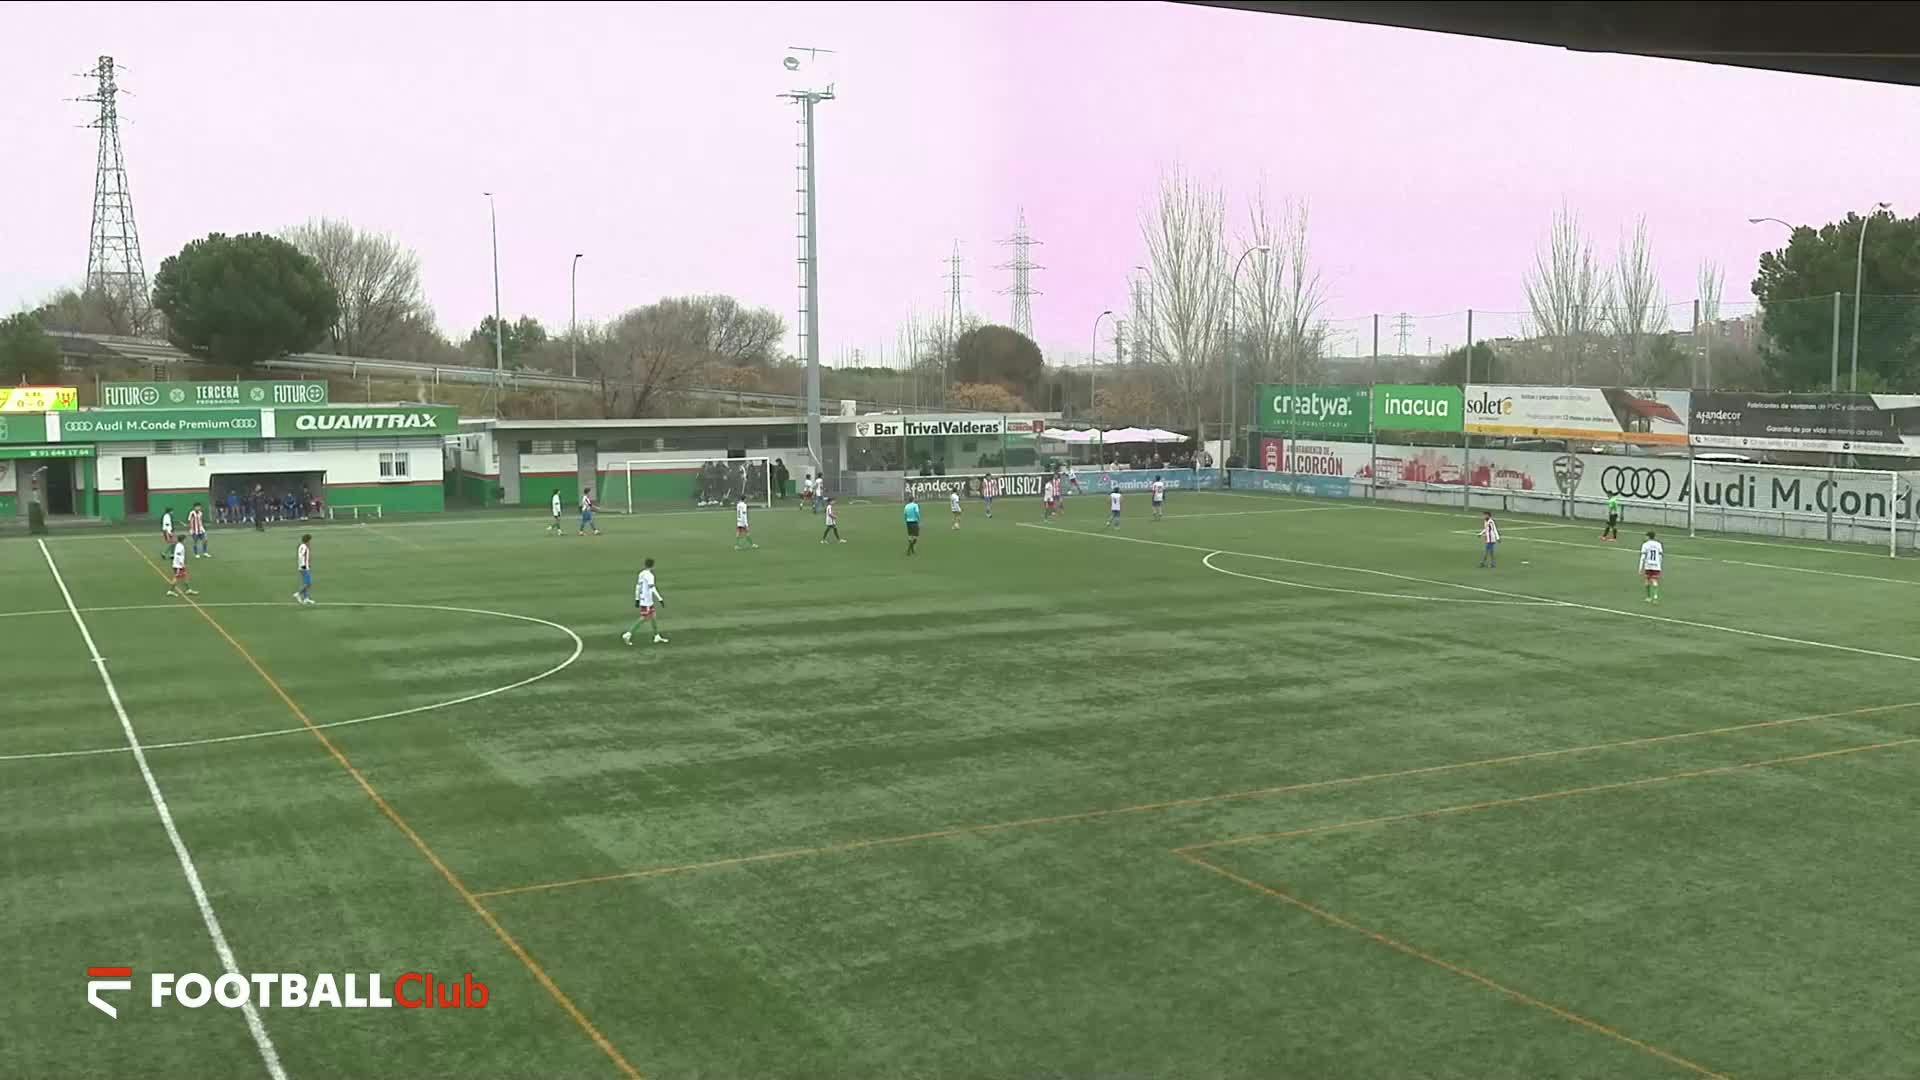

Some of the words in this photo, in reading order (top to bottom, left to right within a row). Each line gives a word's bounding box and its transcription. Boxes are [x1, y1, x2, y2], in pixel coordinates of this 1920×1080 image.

[196, 386, 239, 399] TERCERA
[1385, 393, 1448, 417] inacua
[95, 421, 122, 431] Audi
[127, 421, 176, 430] M.Conde
[179, 419, 230, 429] Premium
[296, 414, 437, 430] QUAMTRAX
[874, 423, 898, 435] Bar
[1678, 474, 1755, 508] Audi
[1771, 477, 1920, 519] M.Cond
